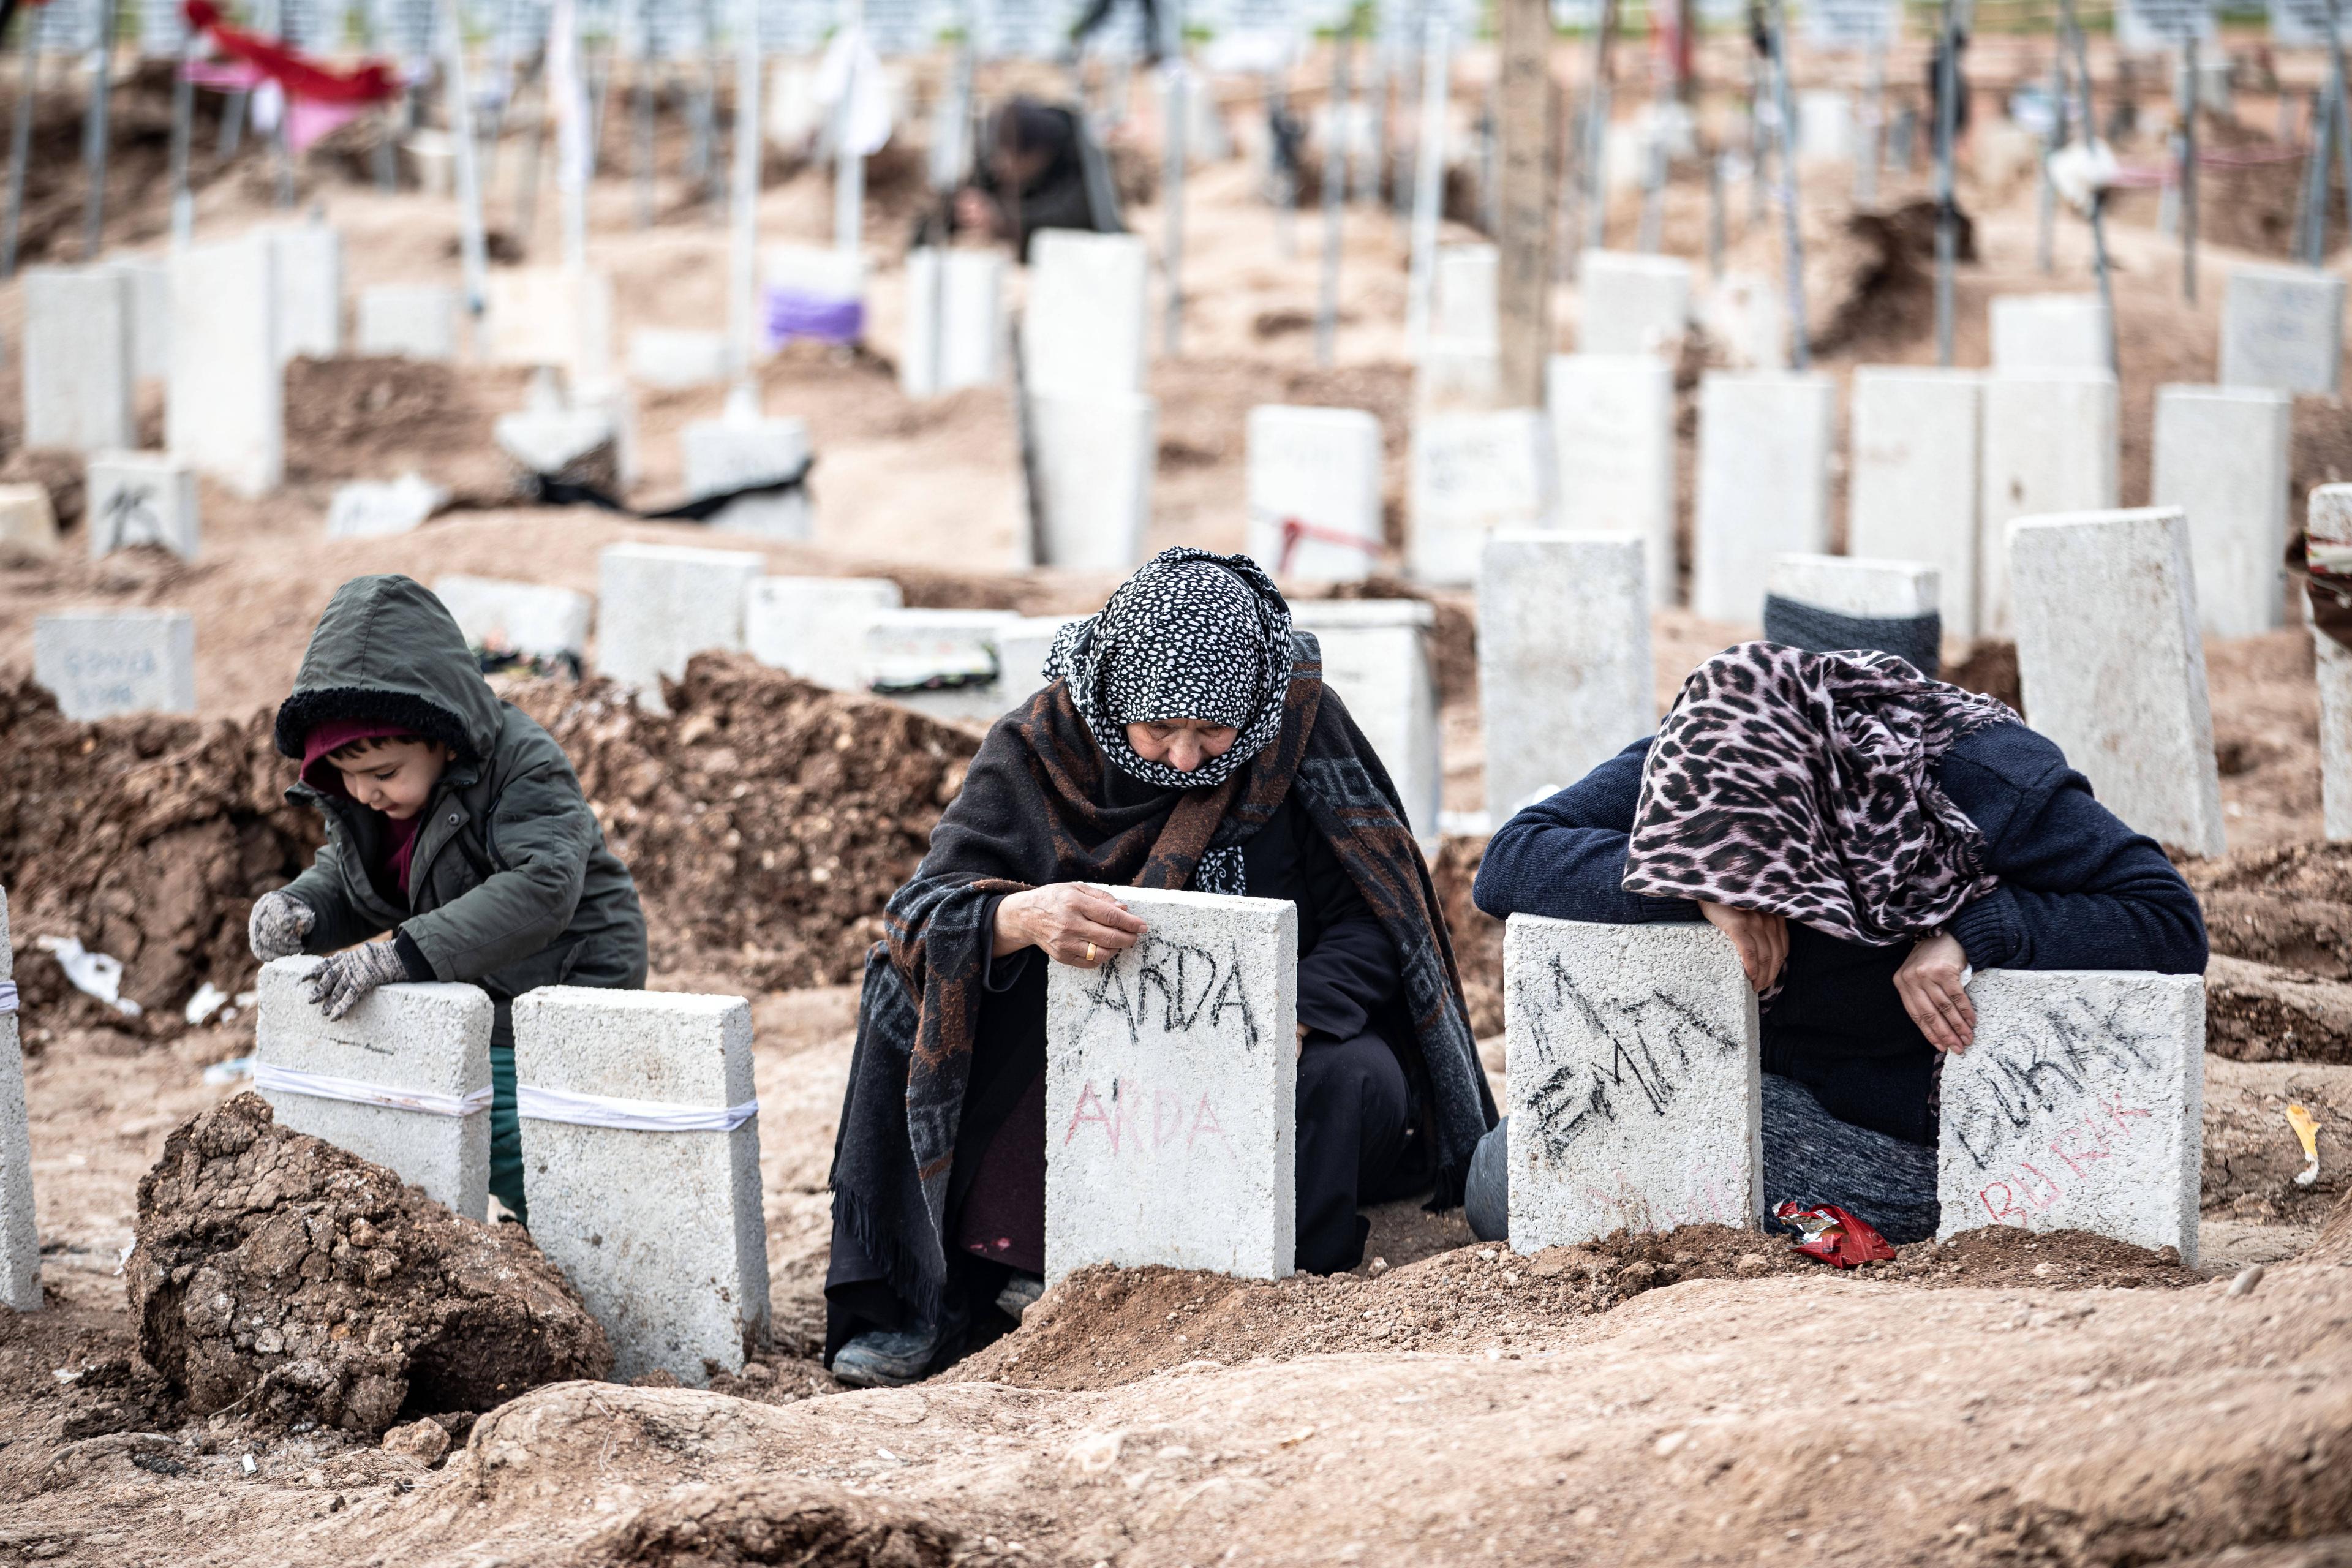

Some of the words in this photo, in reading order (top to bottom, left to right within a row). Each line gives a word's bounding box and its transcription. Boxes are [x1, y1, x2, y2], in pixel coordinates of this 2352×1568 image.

[1069, 930, 1259, 1052] ARDA
[1065, 1077, 1240, 1165] ARDA
[1979, 1091, 2152, 1226] BURAK
